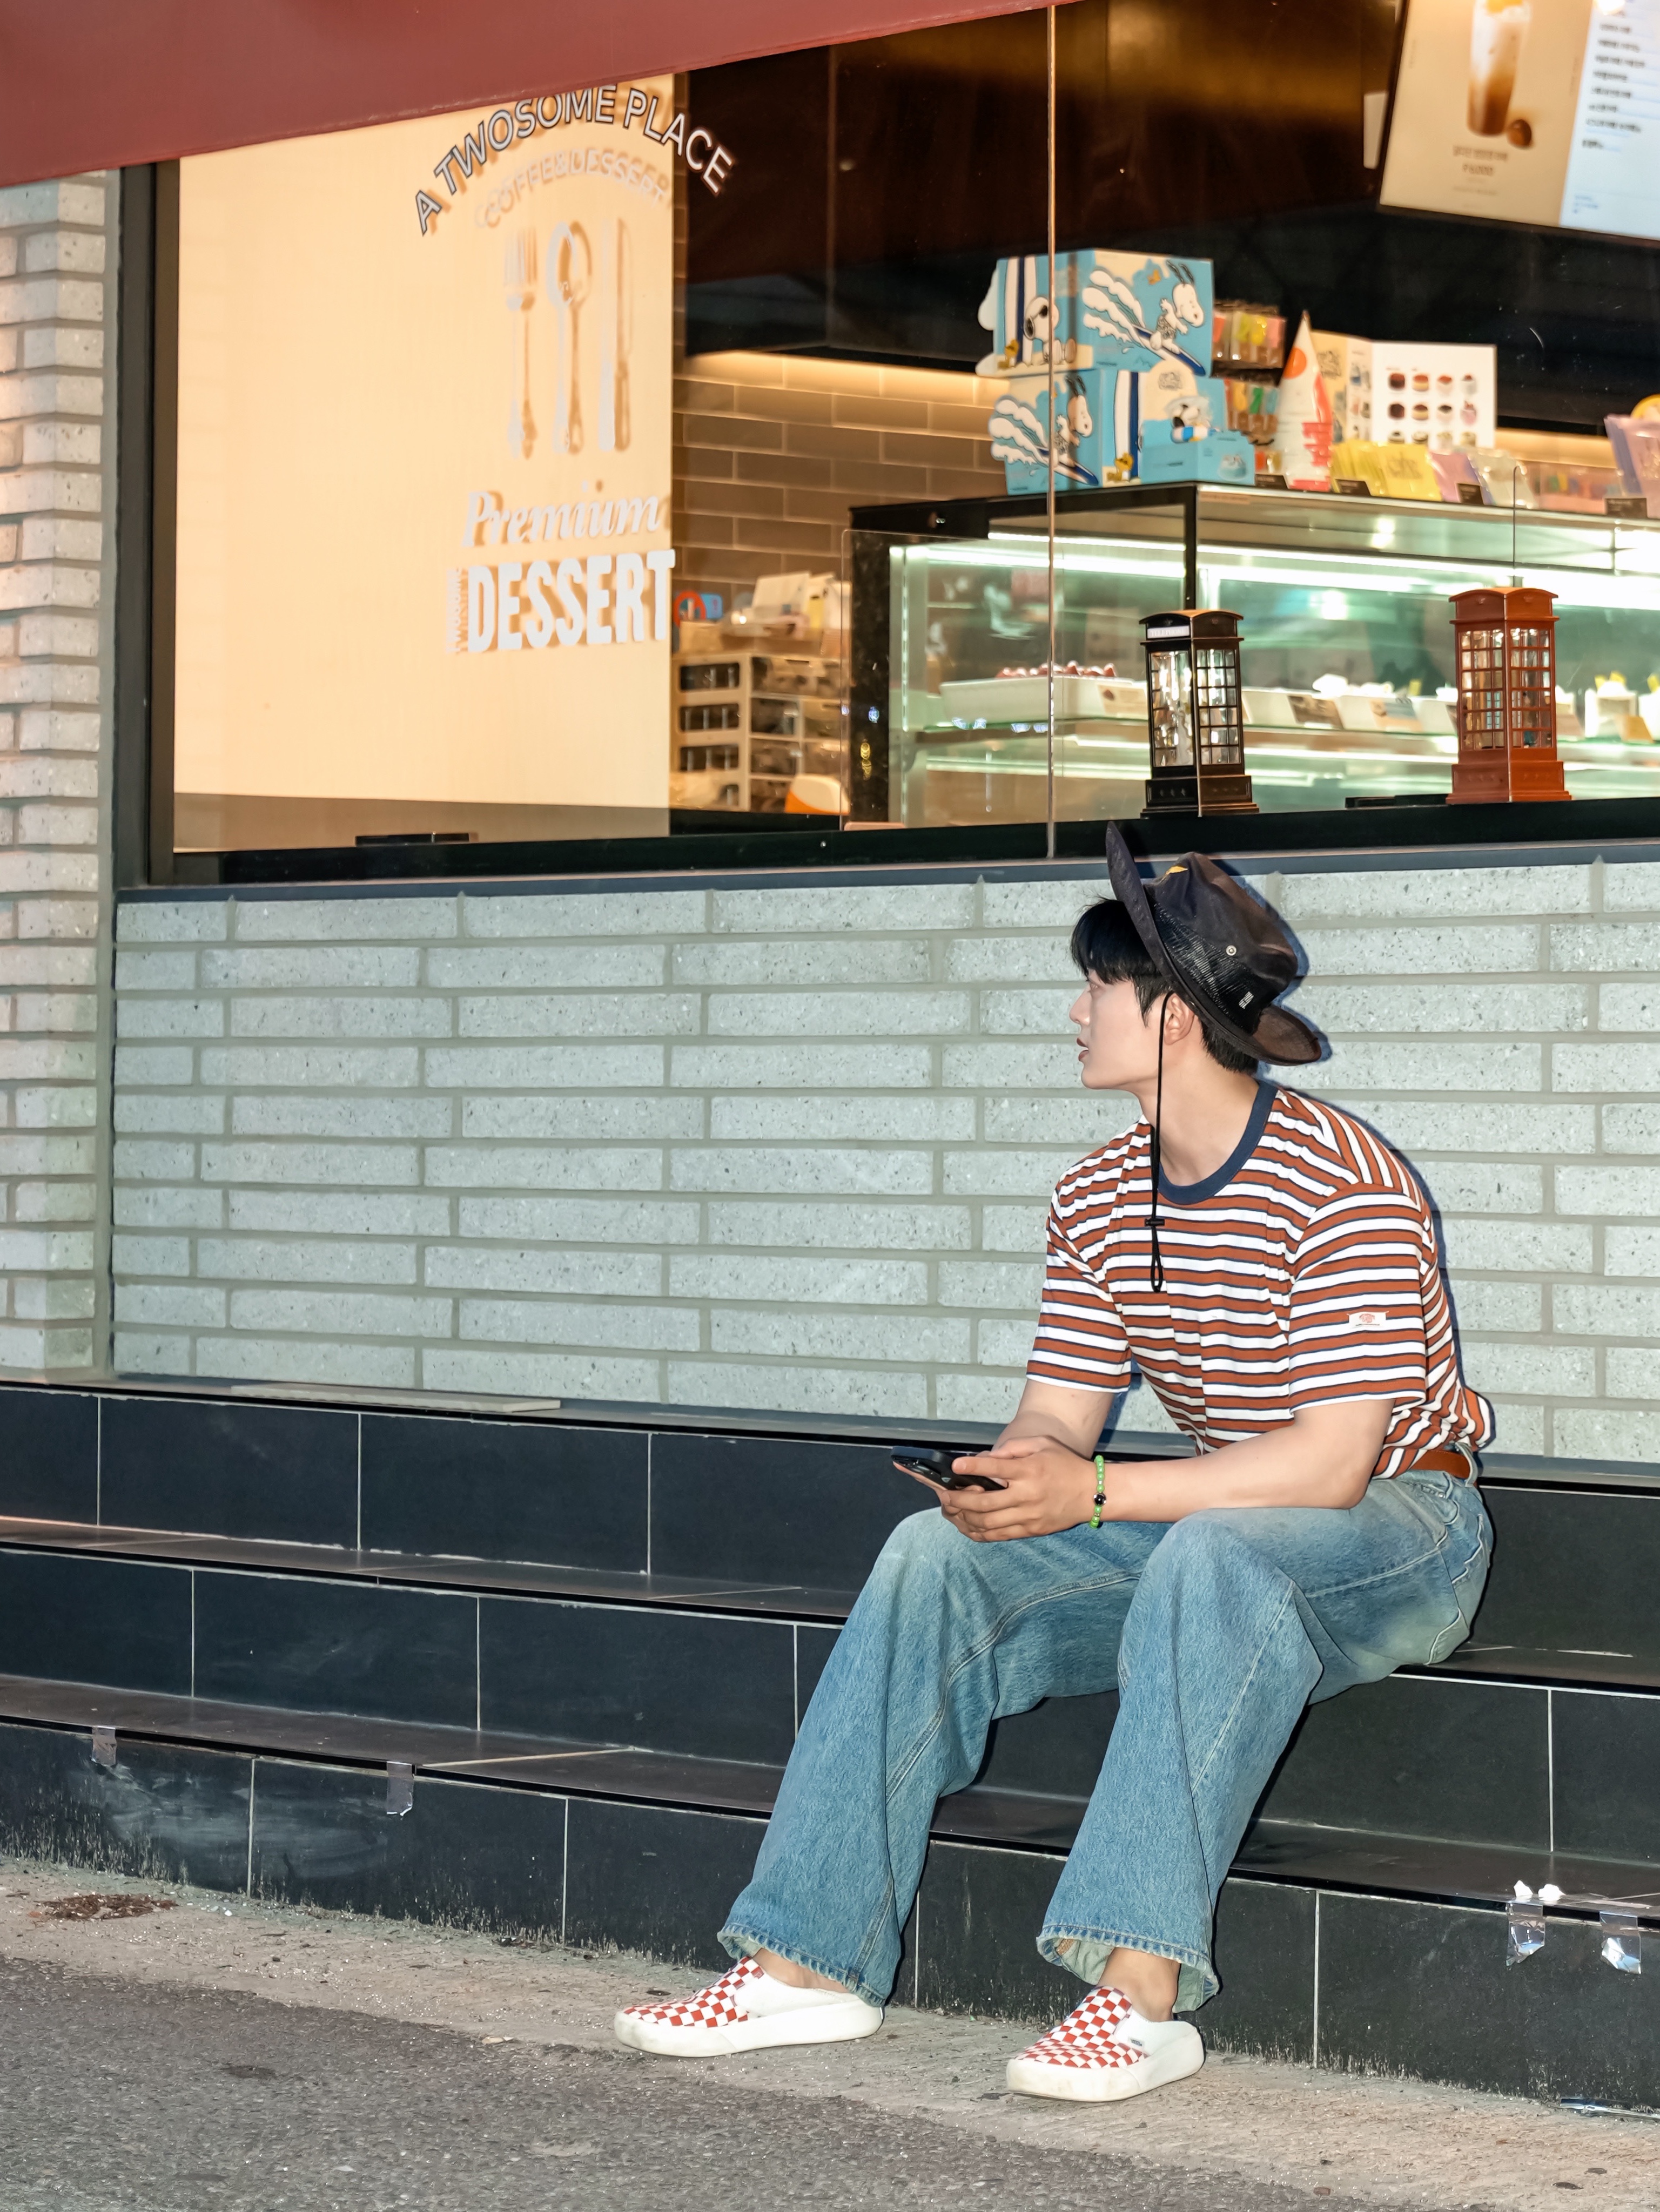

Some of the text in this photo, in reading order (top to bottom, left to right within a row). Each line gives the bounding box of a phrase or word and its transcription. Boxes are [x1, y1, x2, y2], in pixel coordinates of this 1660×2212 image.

[415, 84, 732, 236] A TWOSOME PLACE
[461, 479, 660, 548] Premium
[467, 549, 676, 653] DESSERT
